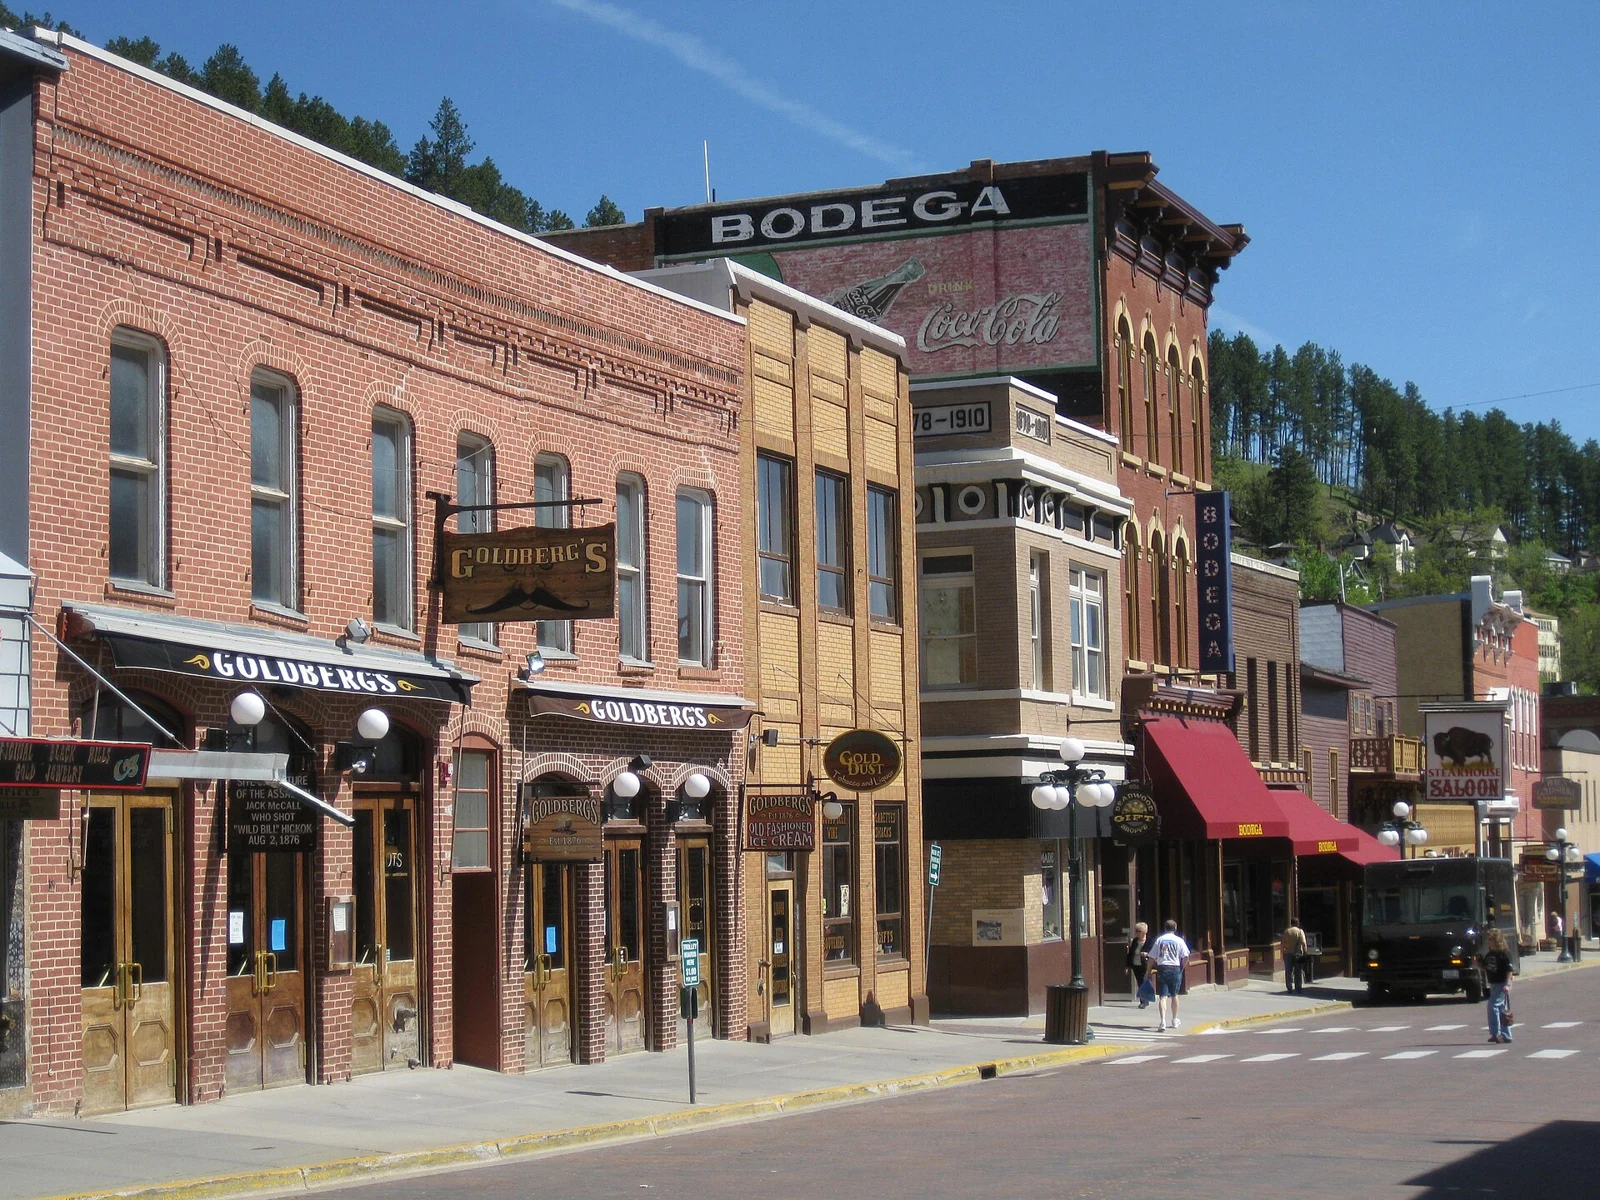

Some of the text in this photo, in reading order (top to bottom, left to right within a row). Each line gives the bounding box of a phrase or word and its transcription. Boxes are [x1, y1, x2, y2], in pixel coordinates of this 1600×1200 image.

[711, 185, 1012, 243] BODEGA
[928, 282, 974, 294] DRINK
[917, 291, 1064, 353] Coca-Cola
[913, 407, 985, 432] 78-1910
[451, 538, 607, 578] GOLDBERG'S
[1203, 506, 1222, 658] BODEGA
[591, 700, 707, 727] GOLDBERG'S
[50, 744, 76, 763] BLACK
[88, 746, 112, 765] HILLS
[839, 750, 880, 765] GOLD
[15, 763, 83, 783] GOLD JEWELRY
[847, 763, 884, 776] DUST
[1428, 768, 1501, 777] STEAKHOUSE
[832, 769, 894, 787] Tobacco and Liquor
[236, 789, 247, 799] OF
[249, 789, 265, 799] THE
[1430, 779, 1499, 797] SALOON
[245, 801, 301, 810] JACK McCALL
[1115, 792, 1153, 811] DEADWOOD
[251, 812, 295, 821] WHO SHOT
[1114, 814, 1154, 822] GIFT
[234, 824, 312, 834] "WILD BILL" HICKOK
[749, 822, 812, 837] OLD FASHIONED
[1238, 824, 1263, 836] BODEGA
[248, 835, 265, 845] AUG
[280, 835, 299, 845] 1876
[563, 837, 582, 845] 1876
[749, 831, 812, 846] ICE CREAM
[1318, 841, 1338, 852] BODEGA
